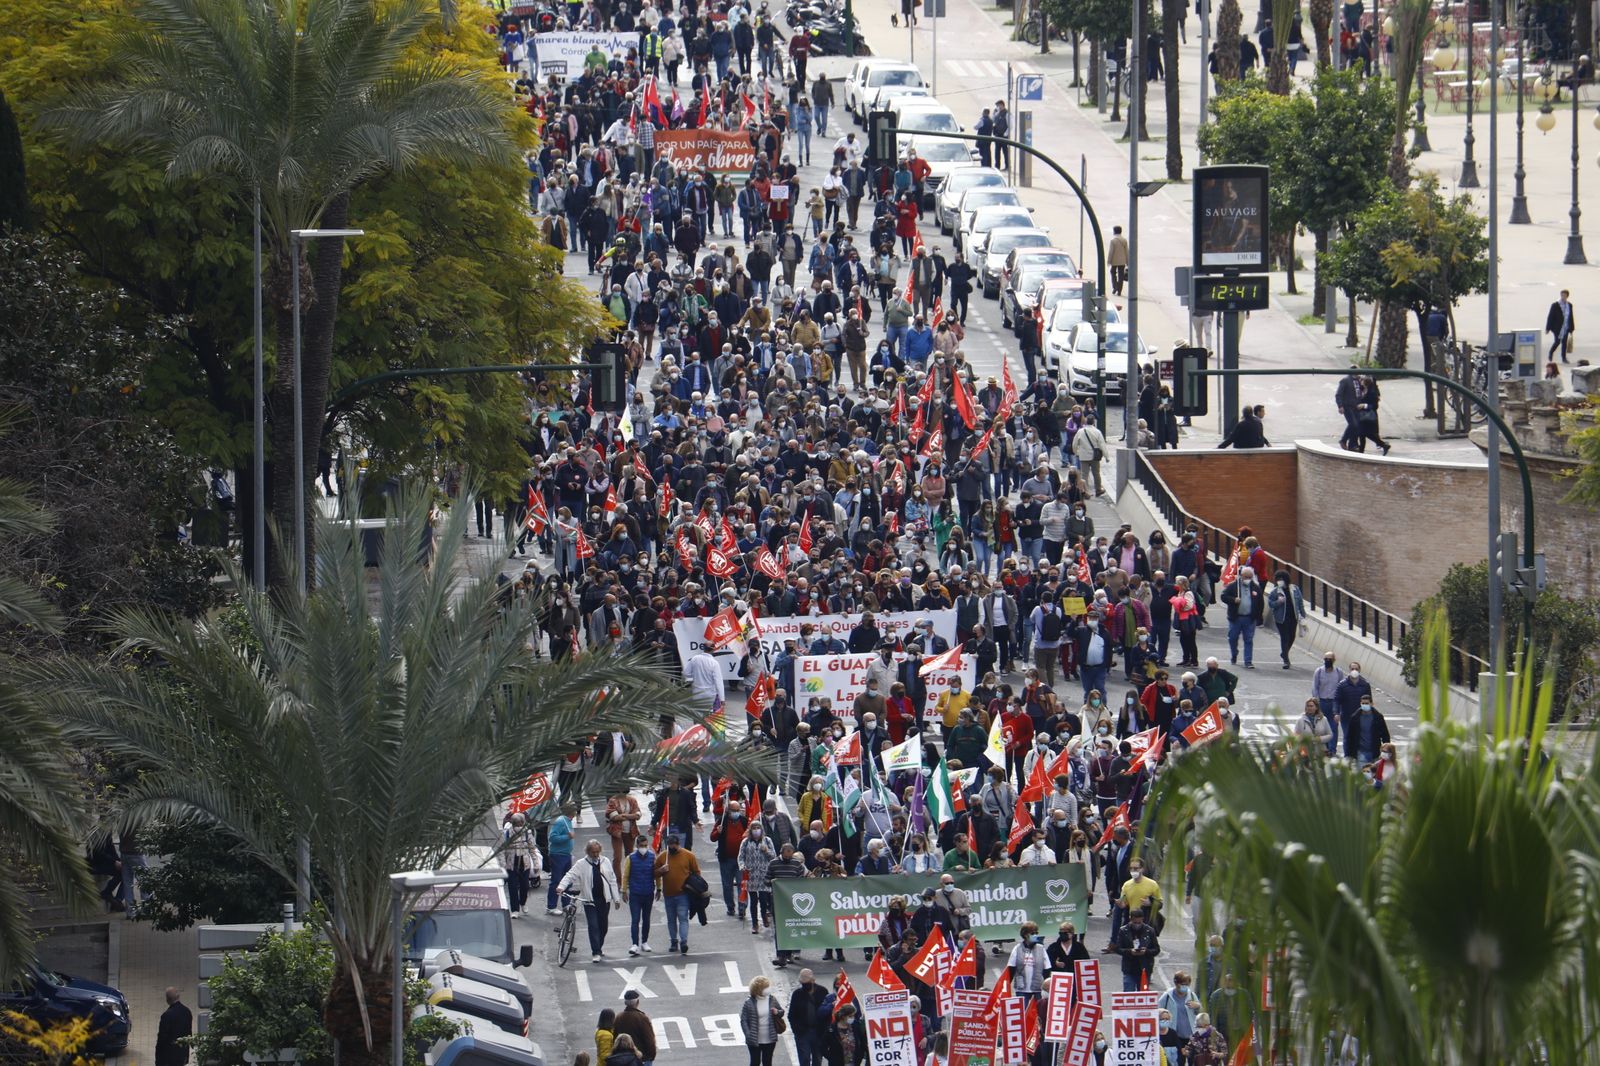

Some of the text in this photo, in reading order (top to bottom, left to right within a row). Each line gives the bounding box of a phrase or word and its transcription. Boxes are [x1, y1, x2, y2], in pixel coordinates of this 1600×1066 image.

[535, 35, 608, 46] marea blanca
[656, 141, 677, 151] POR
[679, 140, 695, 150] UN
[697, 139, 718, 149] PAÍS
[720, 140, 748, 150] PARA
[708, 144, 755, 169] obrer
[1205, 207, 1257, 217] SAUVAGE
[1211, 286, 1257, 300] 12:41
[802, 660, 821, 672] EL
[830, 890, 922, 911] Salveos
[574, 960, 751, 1002] TAXI
[954, 991, 990, 1005] CCO
[1113, 995, 1159, 1007] CCOO
[1049, 977, 1070, 1035] CCOO
[651, 1013, 748, 1050] BU
[868, 1016, 910, 1039] NO
[1005, 998, 1024, 1064] CCOO
[1114, 1017, 1157, 1038] NO
[1067, 1006, 1097, 1066] CCOO
[873, 1039, 890, 1050] RE
[1117, 1039, 1135, 1049] RE
[875, 1050, 902, 1062] COR
[1117, 1051, 1146, 1061] COR
